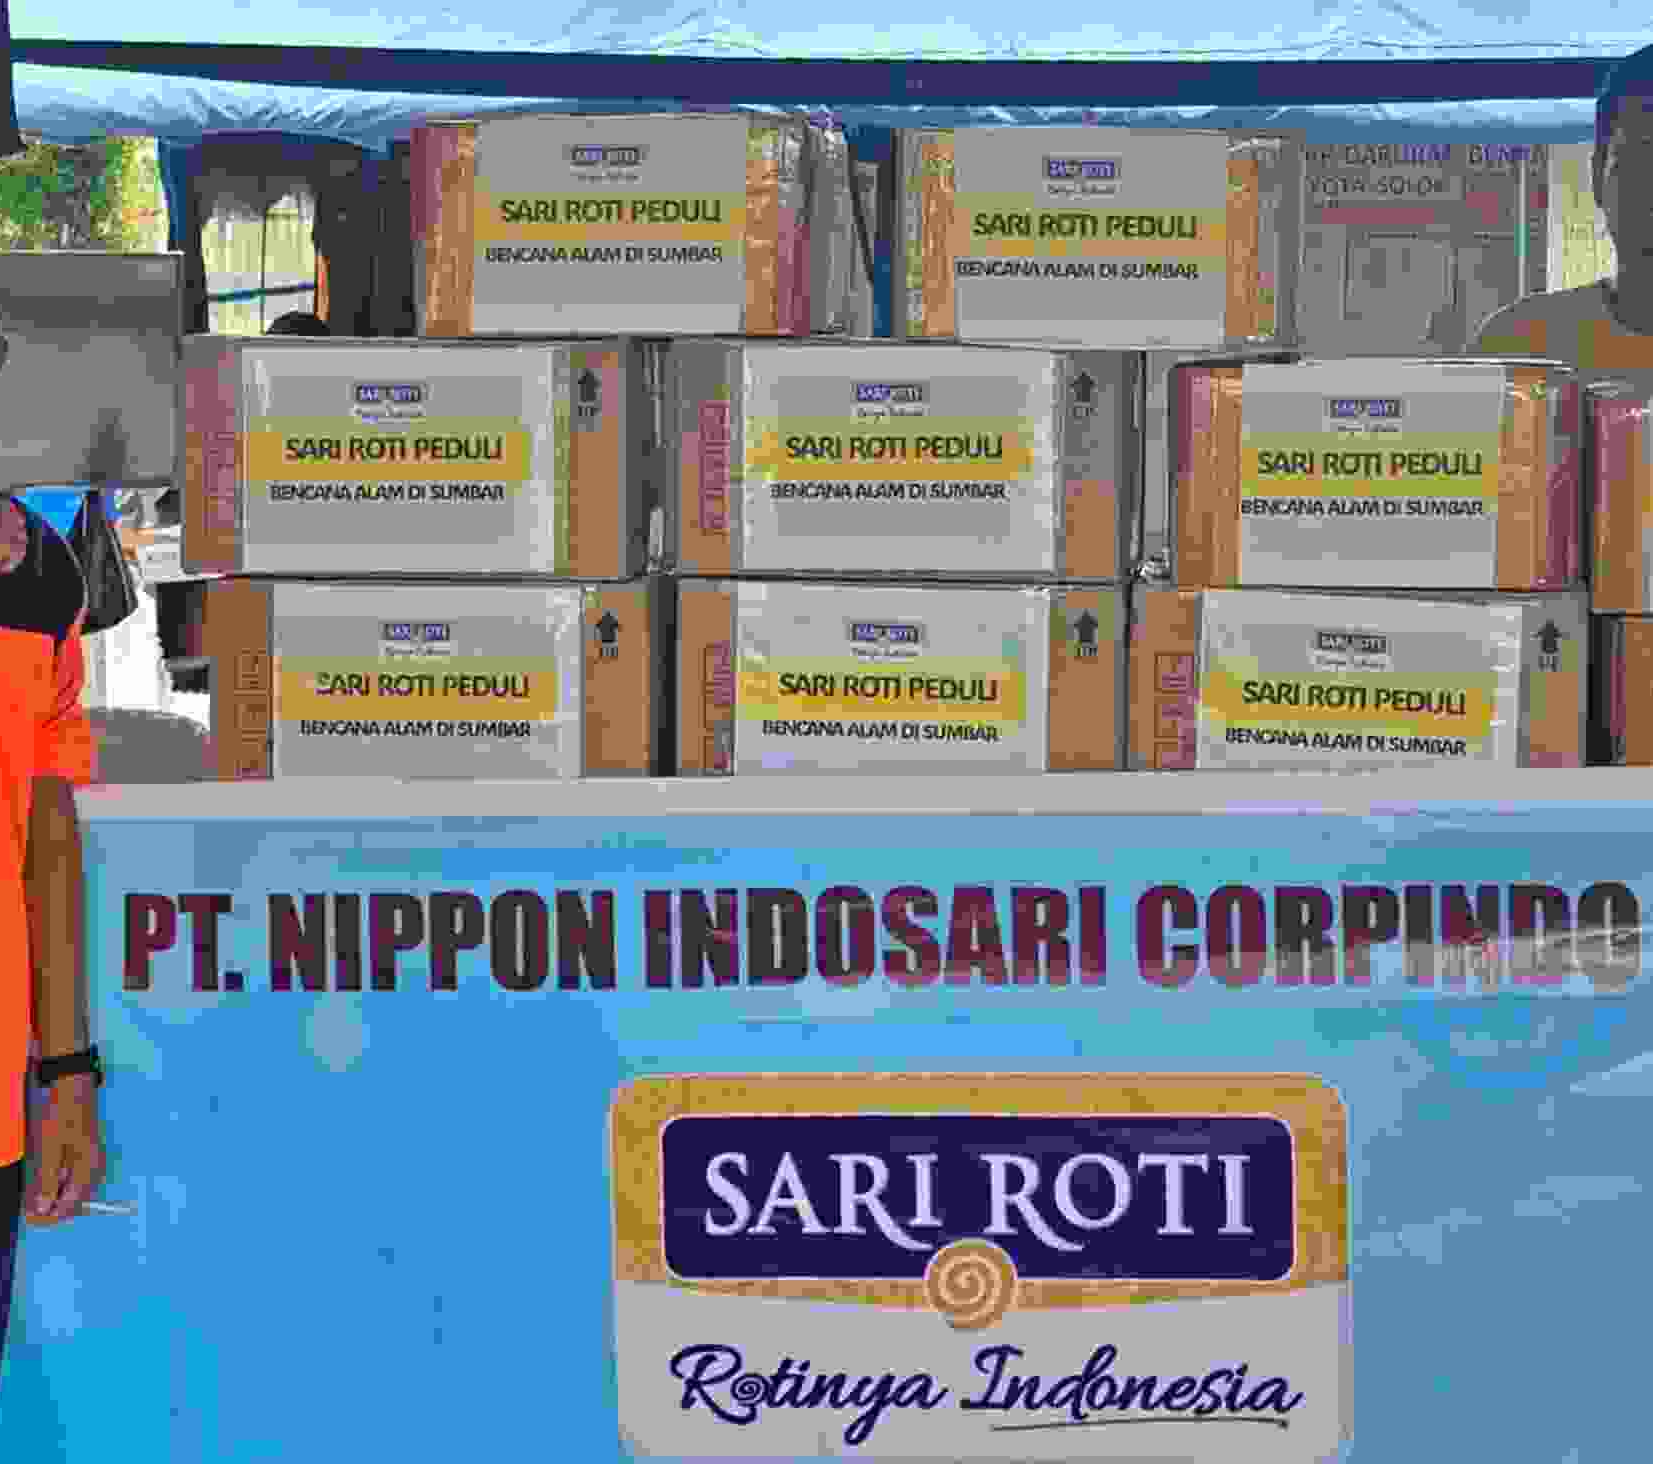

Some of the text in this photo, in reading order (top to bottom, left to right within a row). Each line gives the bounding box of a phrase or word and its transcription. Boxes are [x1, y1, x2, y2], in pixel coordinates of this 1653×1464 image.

[501, 200, 722, 223] SARI ROTI PEDULI
[974, 213, 1196, 239] SARI ROTI PEDULI
[285, 437, 503, 462] SARI ROTI PEDULI
[785, 435, 1003, 461] SARI ROTI PEDULI
[1258, 451, 1482, 475] SARI ROTI PEDULI
[316, 674, 529, 696] SARI ROTI PEDULI
[779, 674, 998, 701] SARI ROTI PEDULI
[1244, 681, 1466, 714] SARI ROTI PEDULI
[122, 890, 244, 991] PT.
[266, 888, 616, 991] NIPPON
[642, 884, 1108, 989] INDOSARI
[1136, 880, 1643, 990] CORPINDO
[704, 1151, 1254, 1252] SARI ROTI
[668, 1342, 1306, 1447] Rotinya Indonesia
